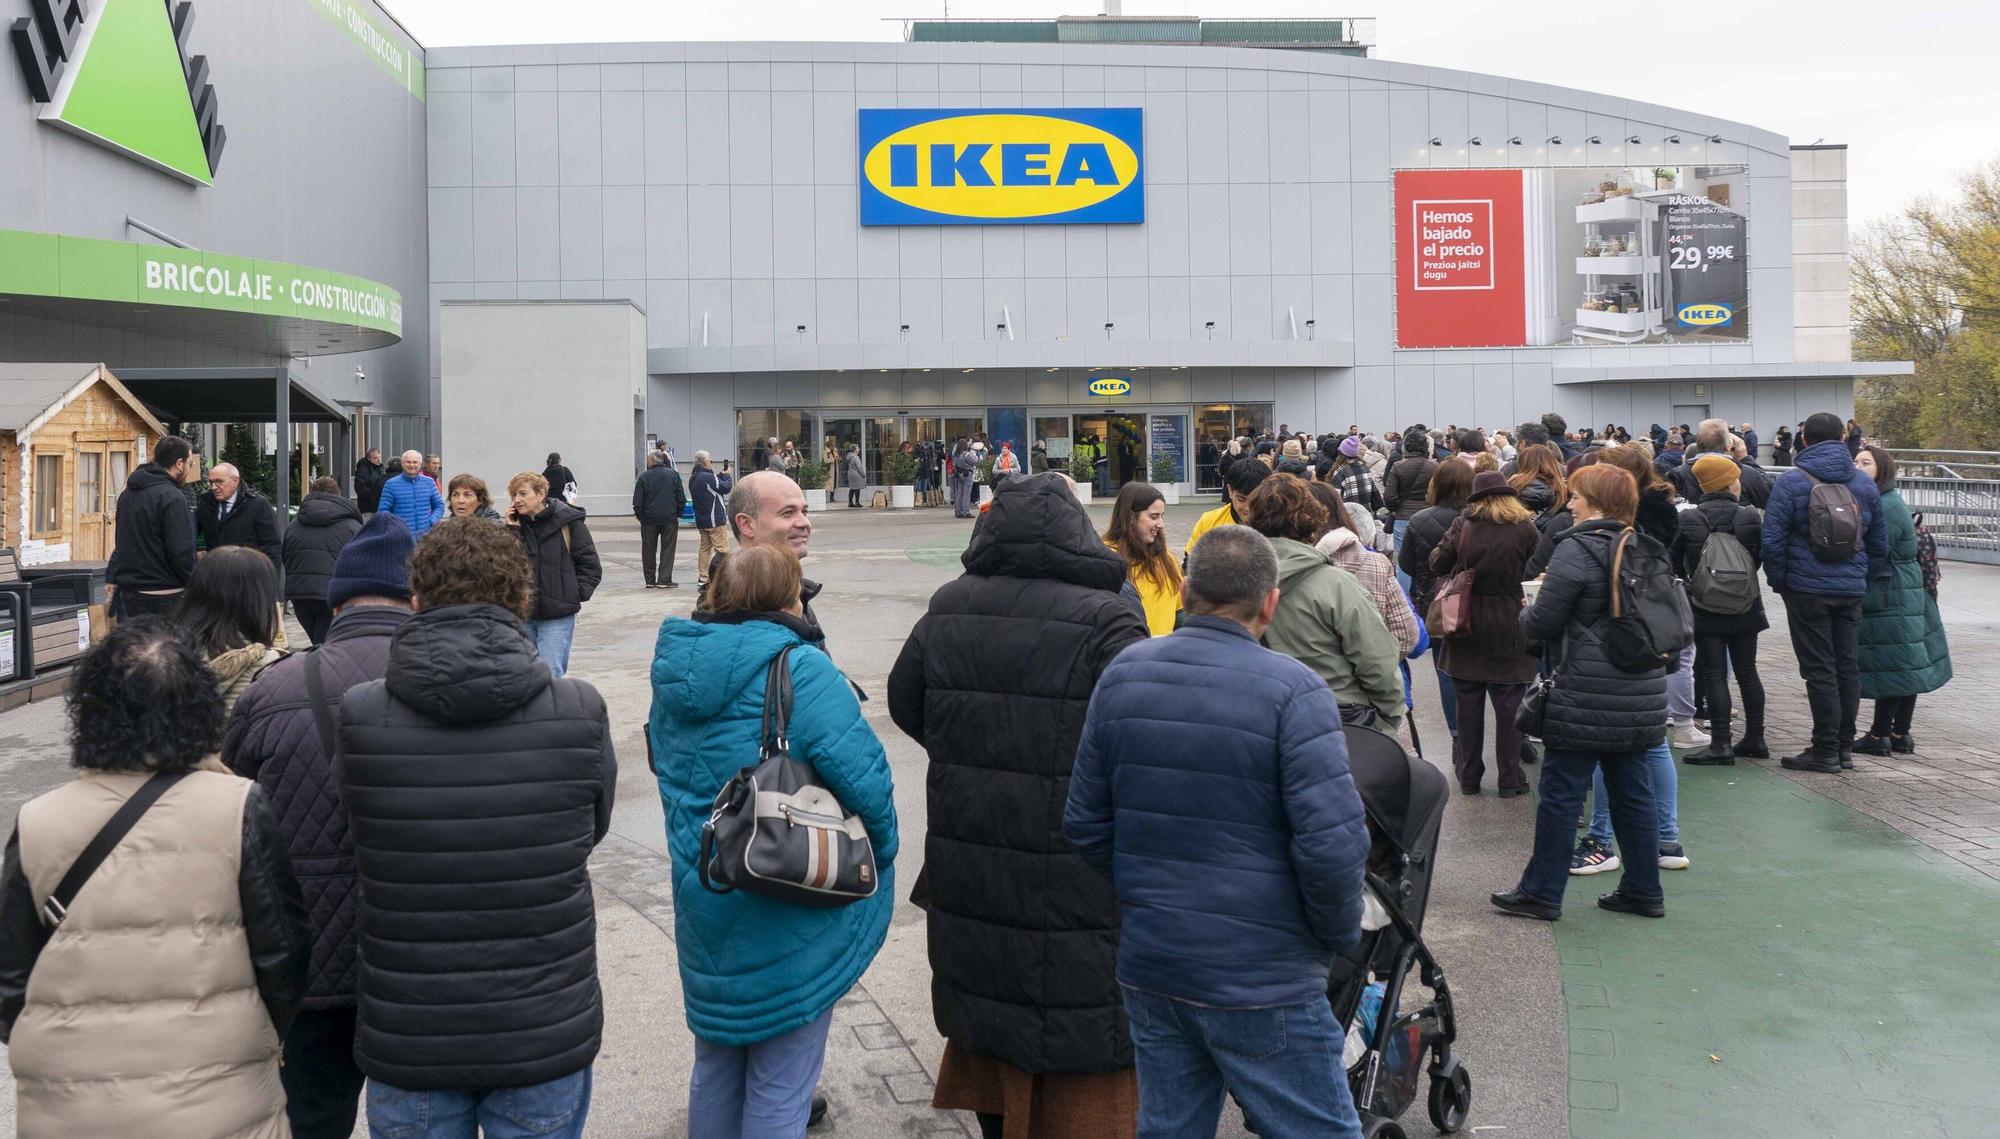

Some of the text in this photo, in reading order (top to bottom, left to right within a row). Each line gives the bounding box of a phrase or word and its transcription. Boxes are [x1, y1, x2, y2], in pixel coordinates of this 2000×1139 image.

[347, 5, 402, 73] CONSTRUCCIÓN
[12, 0, 90, 103] LE
[890, 143, 1120, 187] IKEA
[1423, 210, 1473, 224] Hemos
[1423, 226, 1472, 243] bajado
[1423, 242, 1484, 260] el precio
[1424, 260, 1481, 270] Prezioa jaitsi
[1424, 270, 1447, 280] dugu
[146, 260, 273, 301] BRICOLAJE
[291, 278, 385, 320] CONSTRUCCIÓN
[1683, 310, 1727, 319] IKEA
